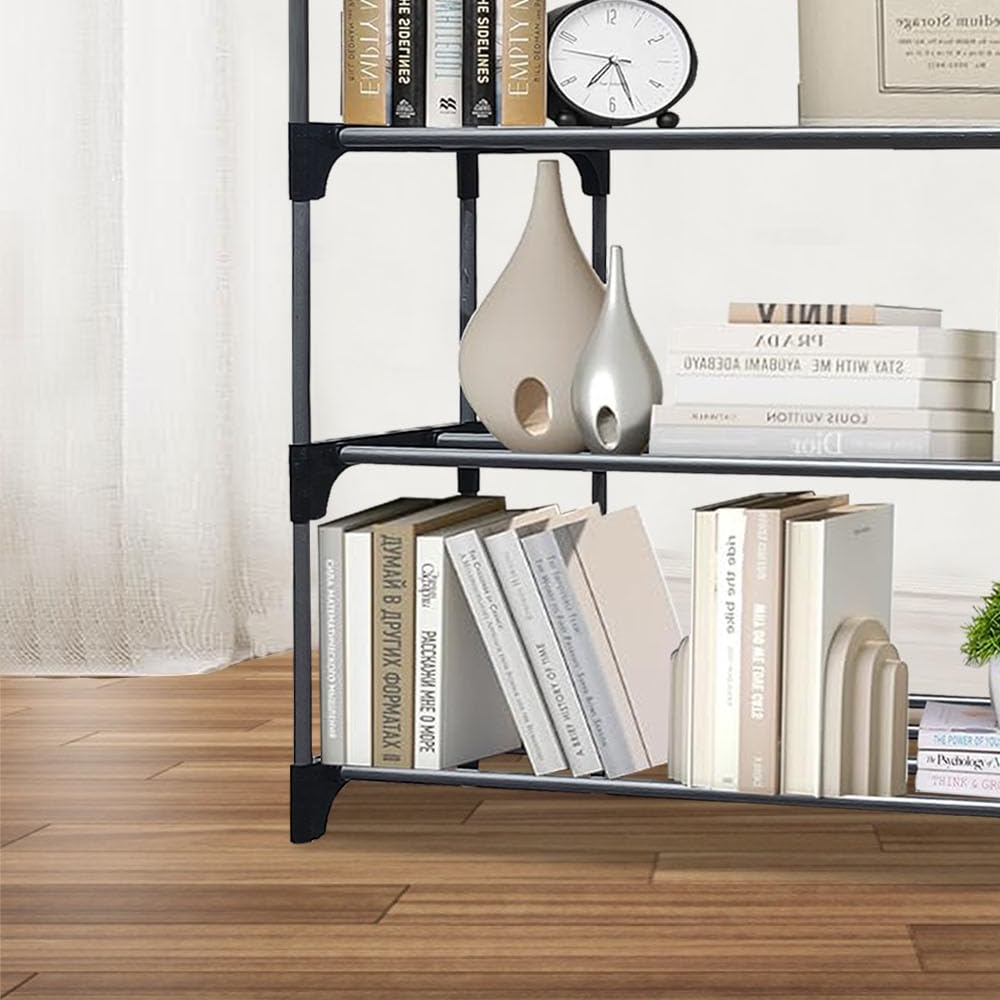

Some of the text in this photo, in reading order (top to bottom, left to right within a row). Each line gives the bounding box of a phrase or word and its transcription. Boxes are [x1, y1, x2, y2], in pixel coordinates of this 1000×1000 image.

[606, 8, 617, 24] 12
[648, 34, 665, 45] 2
[477, 17, 490, 84] SIDELINES
[508, 17, 529, 96] EMPTY
[560, 75, 577, 88] 8
[609, 96, 616, 113] 6
[381, 534, 407, 589] ДУМАЙ
[382, 595, 402, 604] В
[381, 609, 402, 668] ДРУГИХ
[419, 630, 437, 753] РАССКАЖИ МНЕ О МОРЕ
[382, 672, 402, 749] ФОРМАТАХ
[550, 683, 571, 721] HISTORY
[933, 735, 945, 746] THE
[946, 736, 973, 748] POWER
[975, 737, 984, 747] OF
[937, 755, 986, 770] Psychology
[932, 776, 968, 788] THINK
